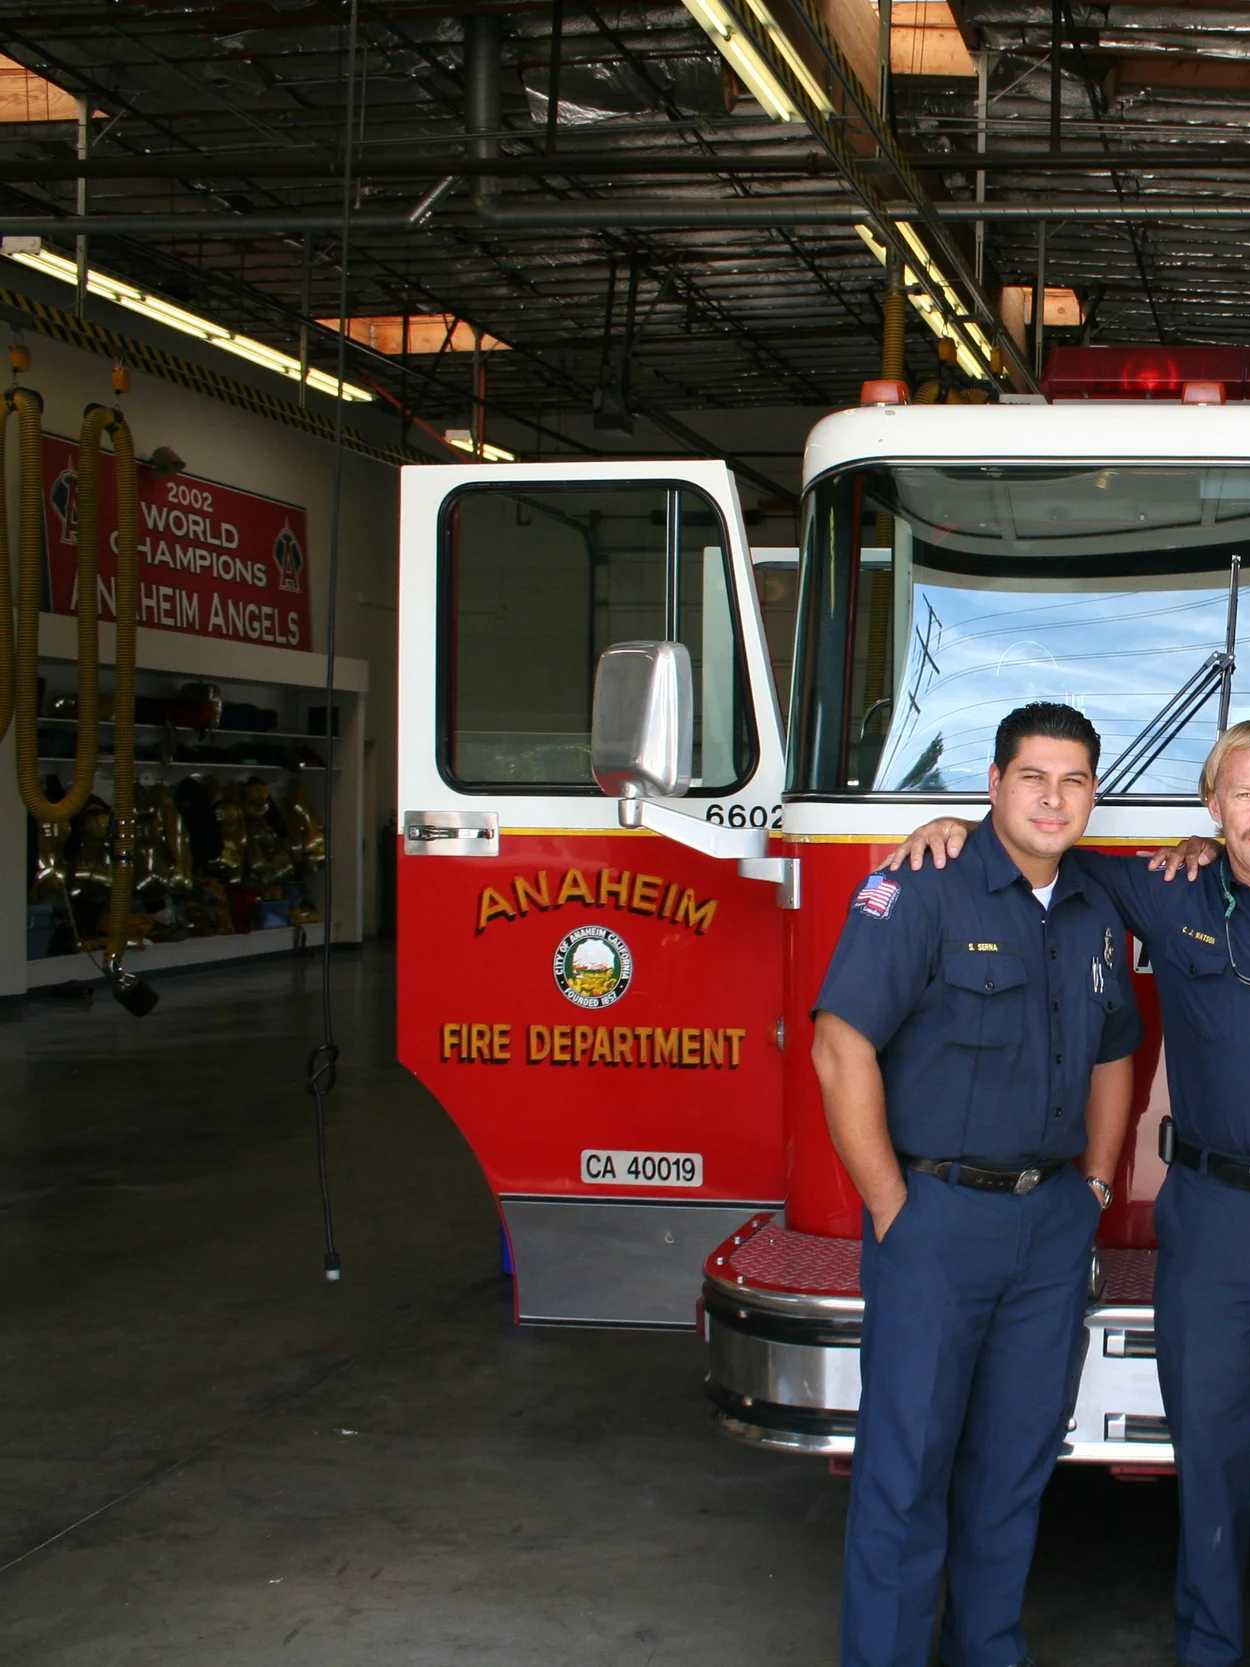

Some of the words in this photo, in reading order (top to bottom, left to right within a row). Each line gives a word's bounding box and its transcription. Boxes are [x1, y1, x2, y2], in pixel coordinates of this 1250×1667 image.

[166, 482, 214, 512] 2002
[140, 502, 239, 549] WORLD
[70, 572, 200, 631] NHEIM
[208, 592, 300, 646] ANGELS
[706, 804, 782, 829] 6602
[476, 868, 719, 935] ANAHEIM
[559, 941, 570, 953] OF
[569, 928, 607, 943] ANAHEIM
[555, 954, 564, 975] CITY
[607, 934, 630, 979] CALIFORNIA
[564, 988, 599, 1007] FOUNDED
[601, 991, 617, 1005] 1857
[441, 1023, 511, 1062] FIRE
[527, 1025, 746, 1069] DEPARTMENT
[585, 1154, 616, 1180] CA
[627, 1157, 696, 1182] 40019
